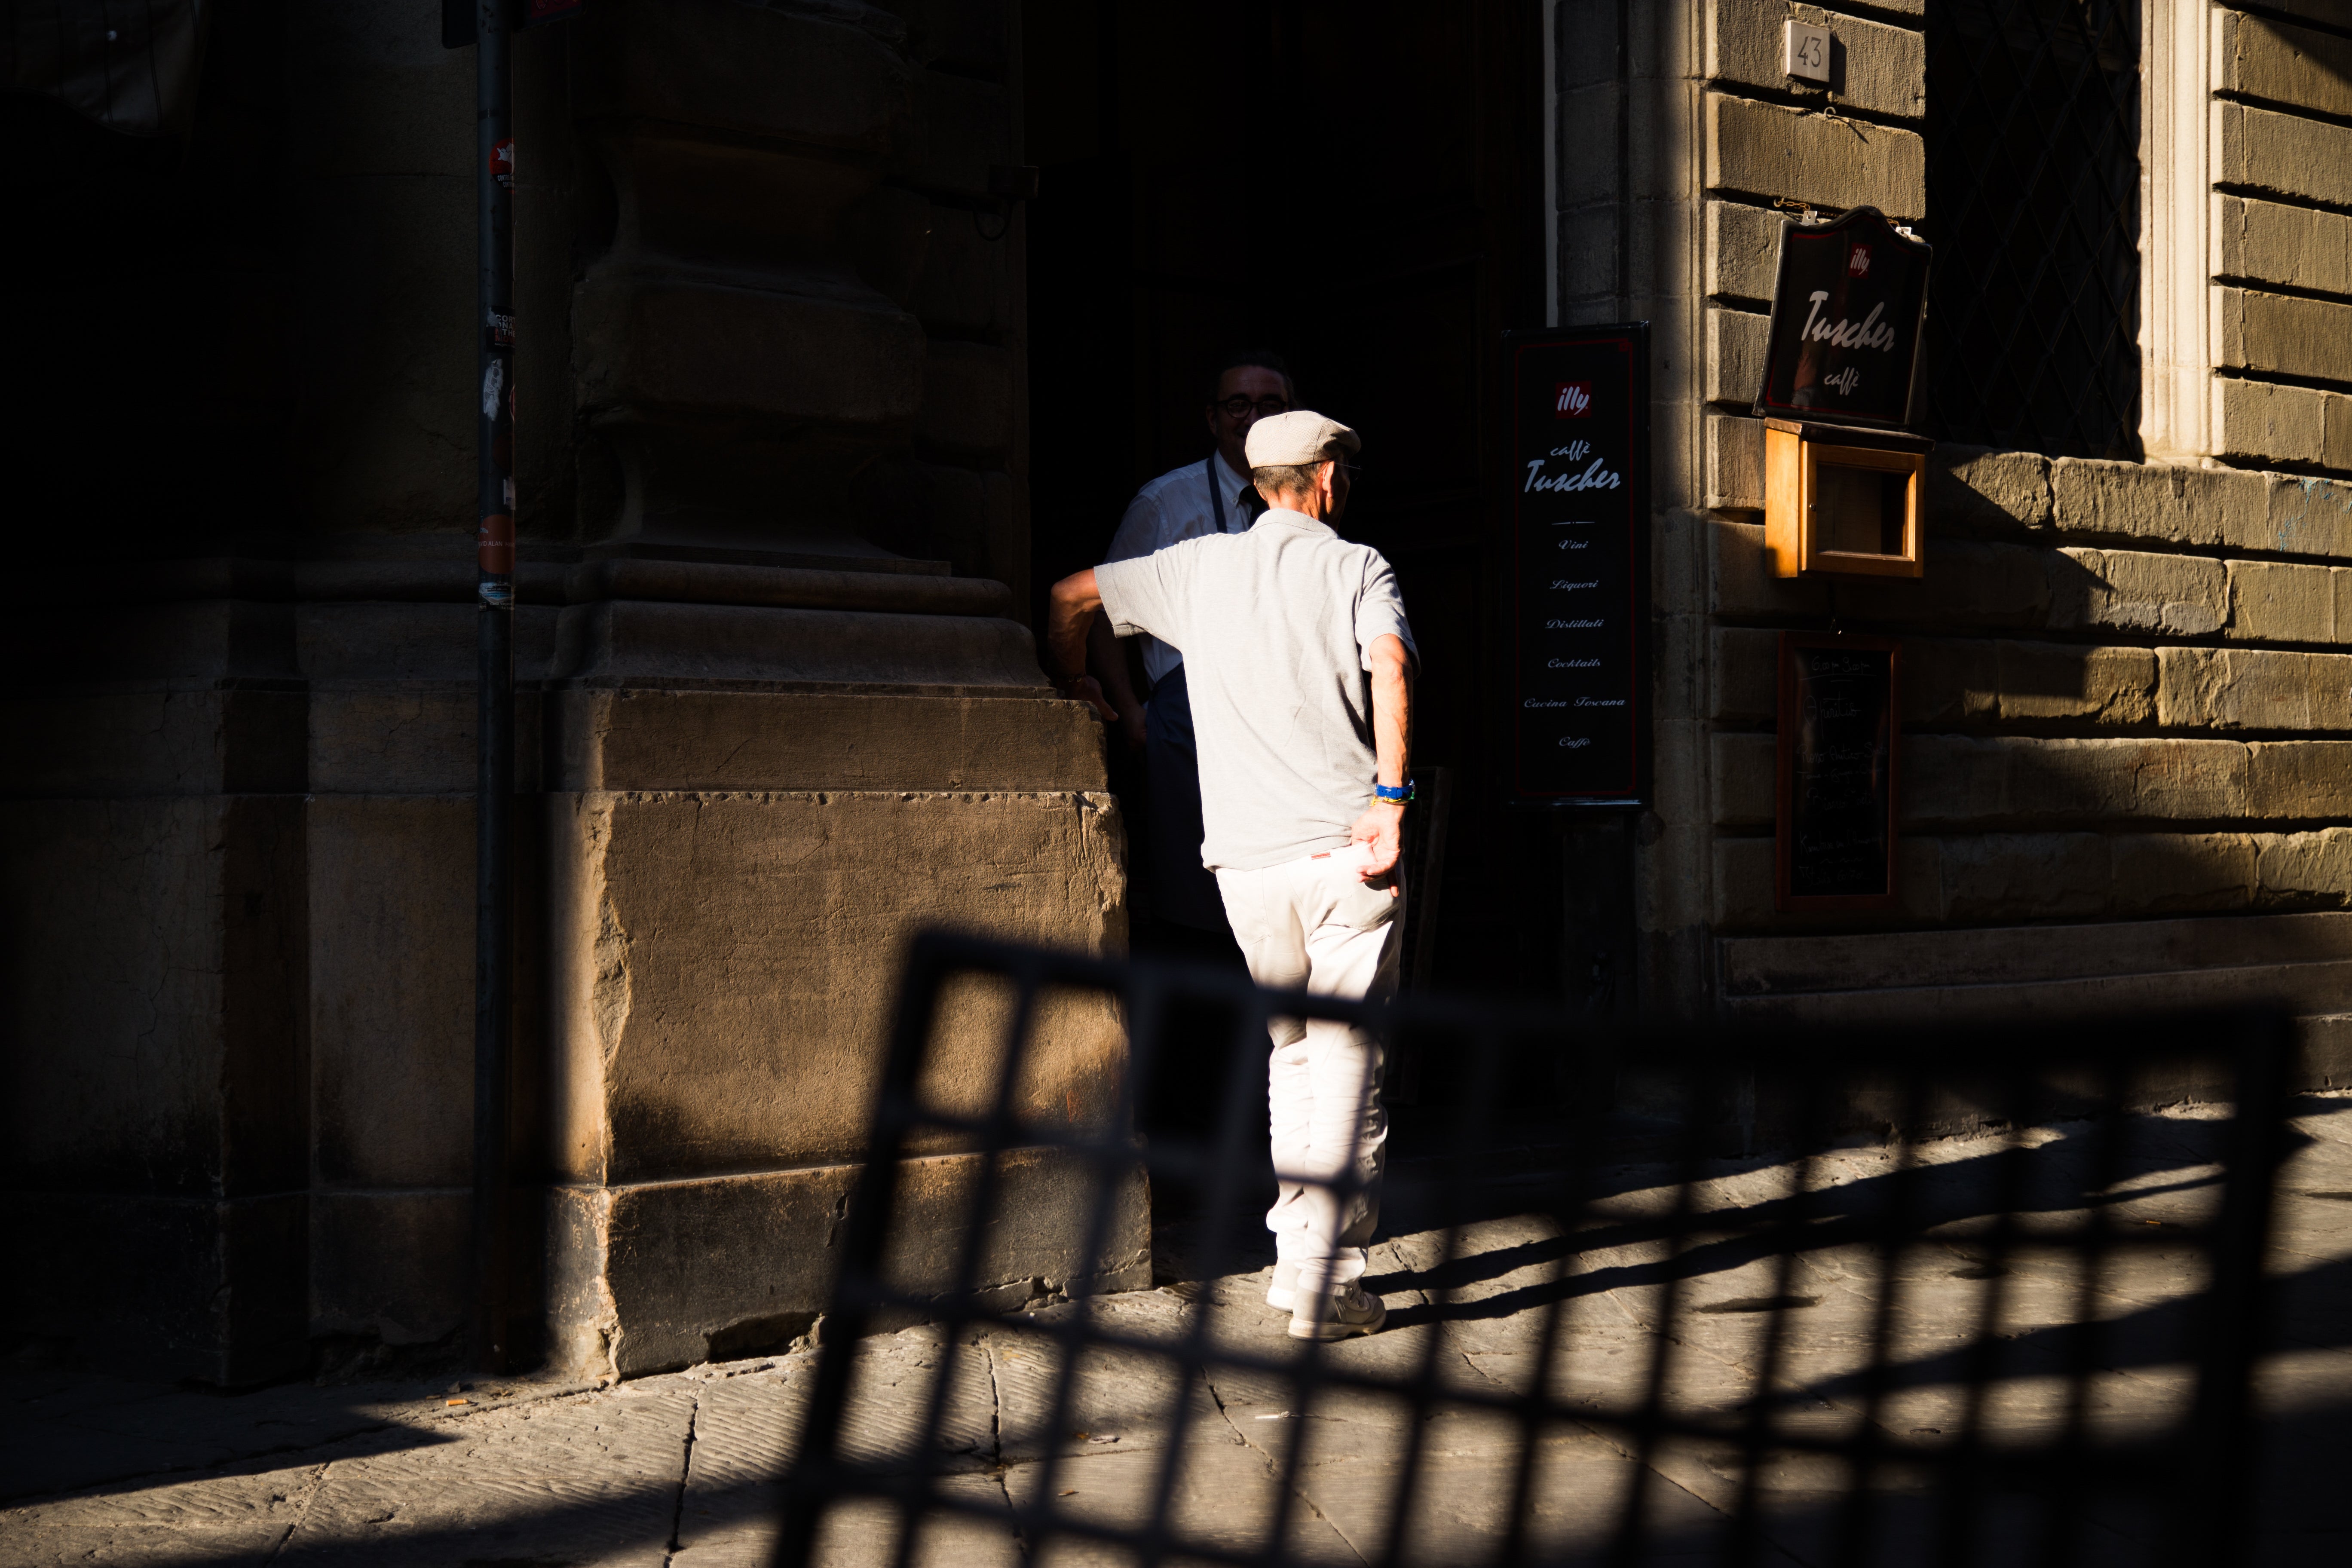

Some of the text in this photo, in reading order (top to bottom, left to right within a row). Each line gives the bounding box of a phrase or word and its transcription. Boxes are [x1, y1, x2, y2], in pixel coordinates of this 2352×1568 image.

[1797, 36, 1822, 67] 43
[1850, 248, 1870, 275] illy
[1801, 291, 1895, 352] Tuscher
[1824, 367, 1860, 395] caffè
[1557, 386, 1589, 416] illy
[1550, 439, 1590, 461] caffè
[1525, 458, 1620, 493] Tuscher
[1559, 539, 1589, 549] Vini
[1549, 579, 1599, 591] Liquori
[1545, 619, 1604, 629] Distillati
[1548, 658, 1601, 668] Cocktails
[1524, 696, 1626, 708] Cucina Toscana
